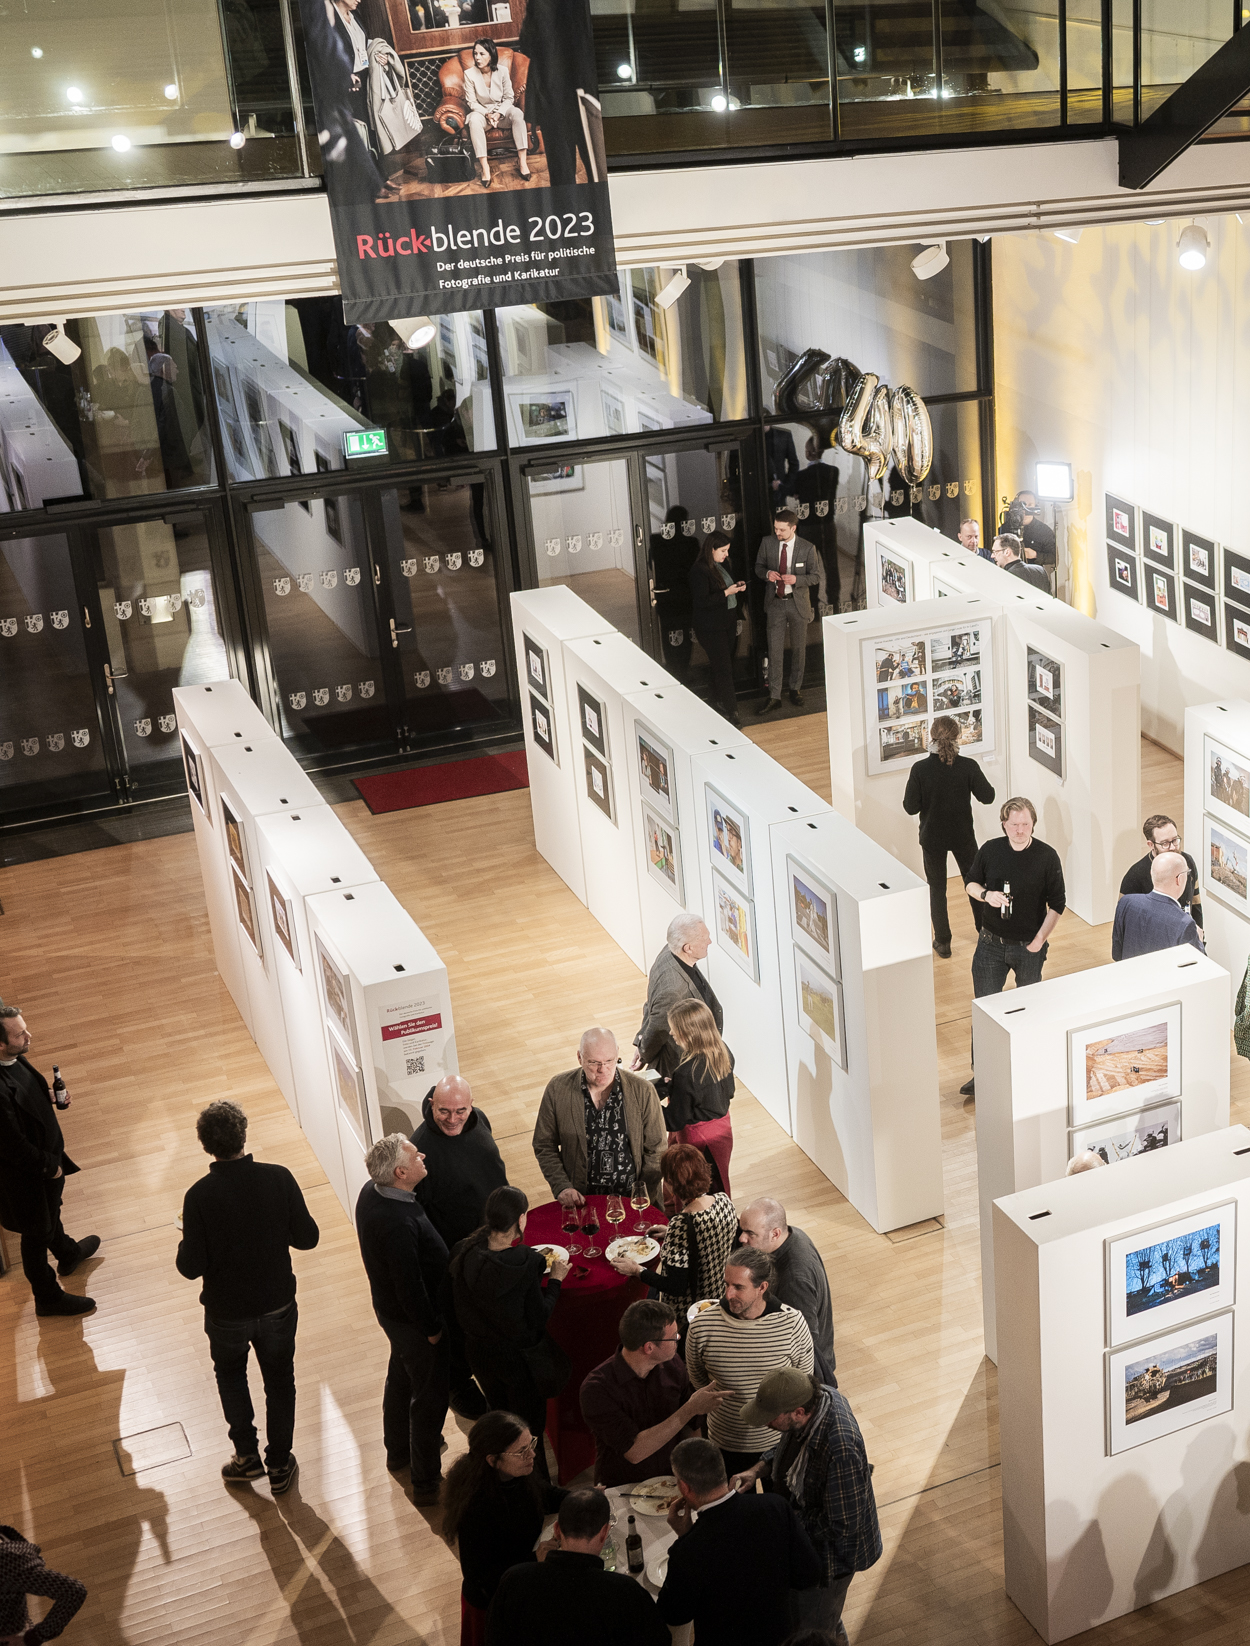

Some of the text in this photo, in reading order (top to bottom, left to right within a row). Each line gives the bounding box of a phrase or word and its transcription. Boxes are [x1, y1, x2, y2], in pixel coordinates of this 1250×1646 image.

[528, 212, 595, 242] 2023
[436, 246, 596, 272] Der deutsche Preis für politische
[439, 267, 560, 290] Fotografie und Karikatur
[388, 1024, 408, 1032] Wählen
[401, 1023, 438, 1035] Publikumspreis!
